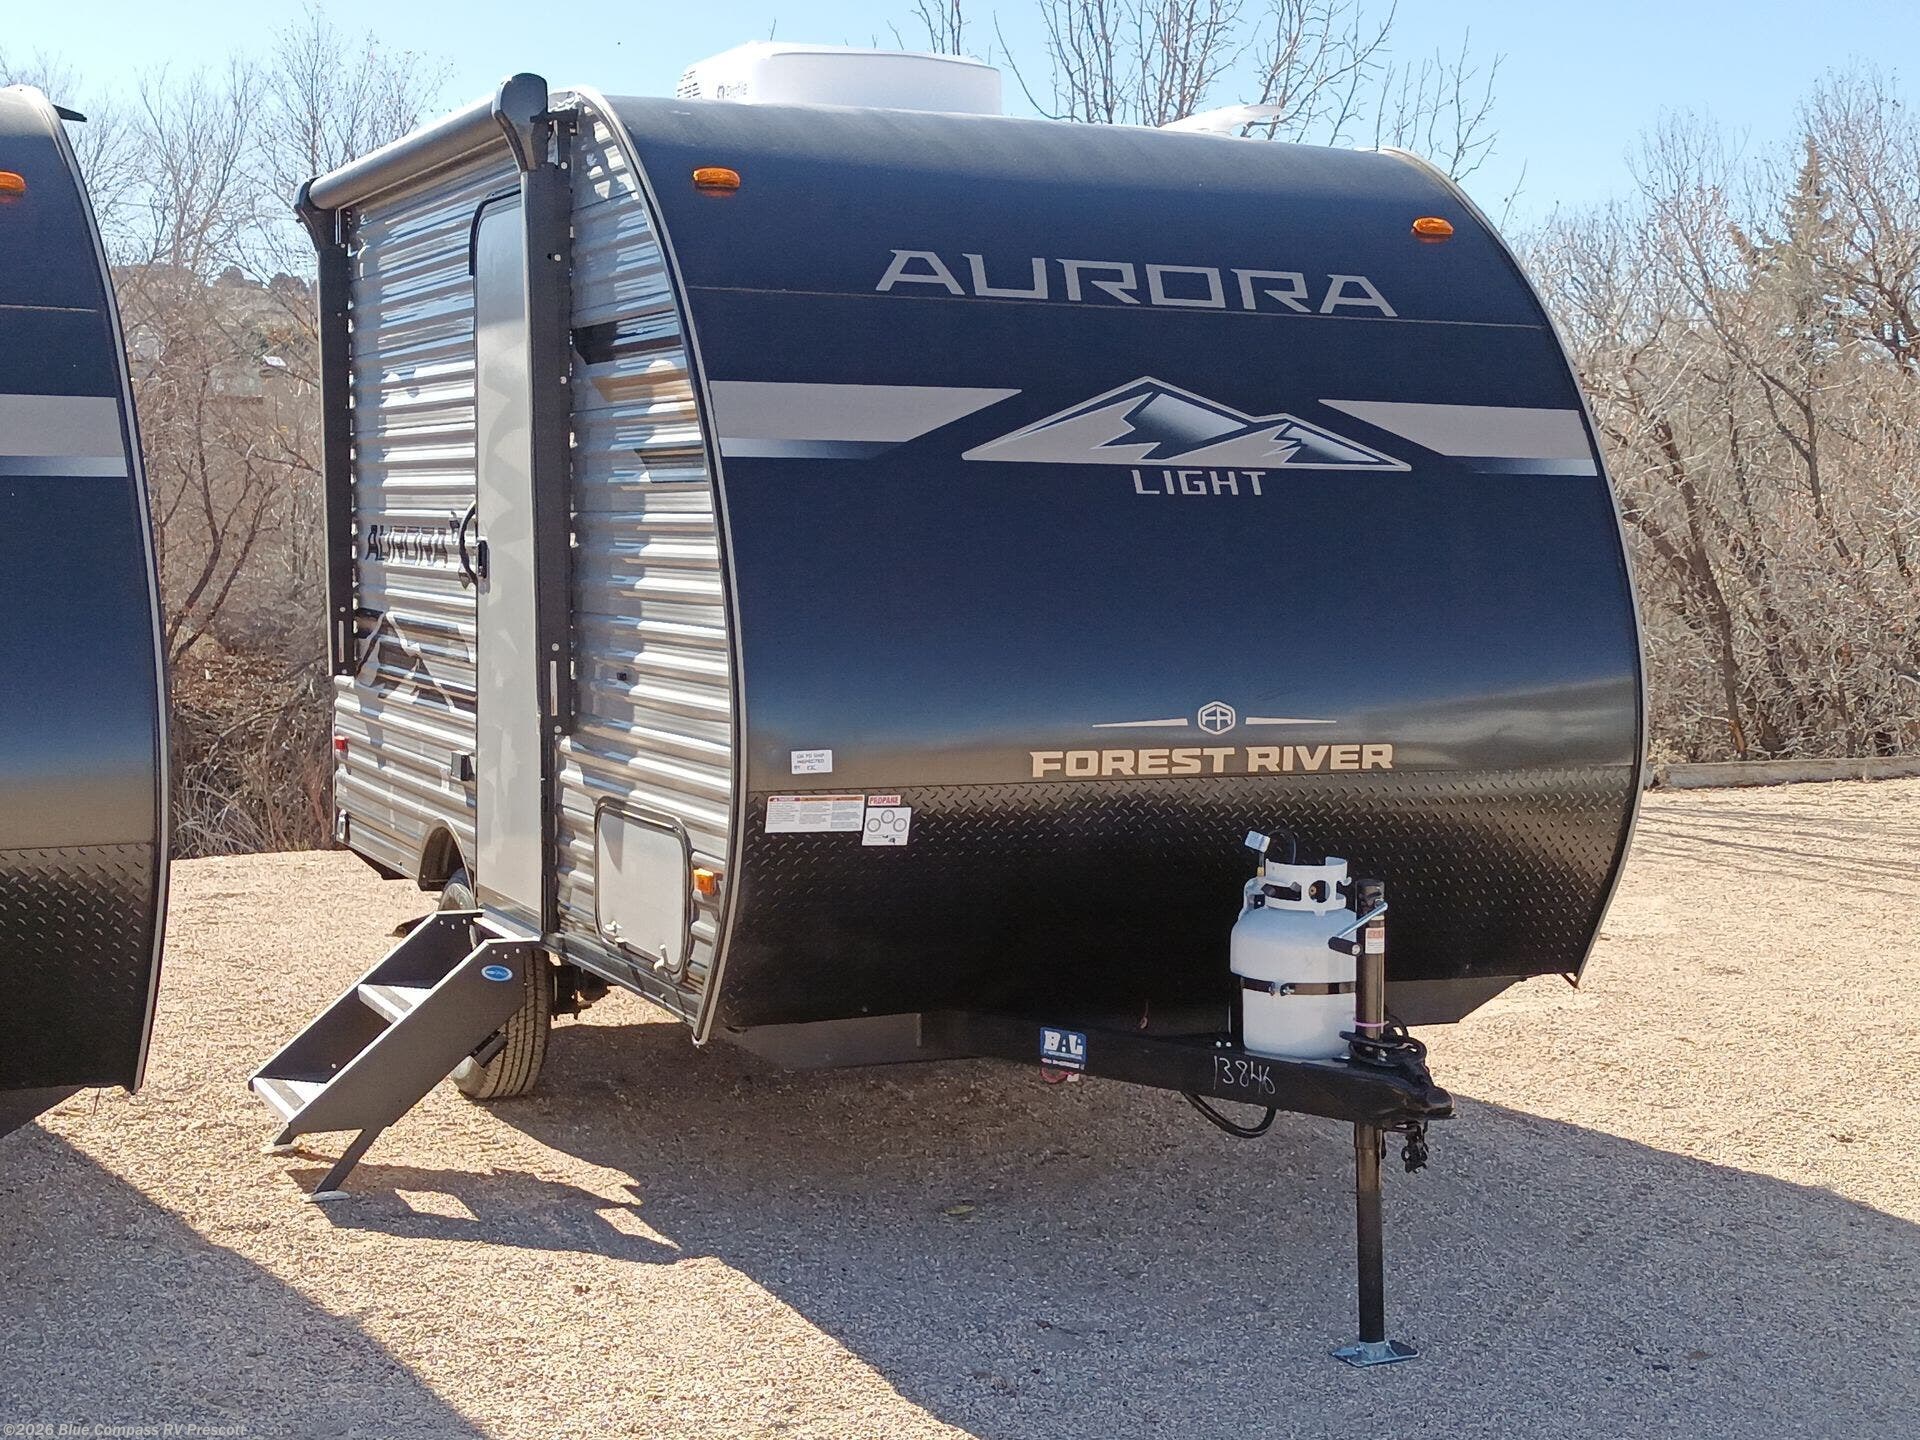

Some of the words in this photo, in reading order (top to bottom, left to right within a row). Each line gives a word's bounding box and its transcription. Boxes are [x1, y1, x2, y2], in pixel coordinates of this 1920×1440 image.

[875, 248, 1398, 317] AURORA
[1131, 469, 1267, 496] LIGHT
[1029, 747, 1236, 778] FOREST
[1245, 743, 1394, 773] RIVER
[868, 796, 900, 805] PROPANE
[1213, 1055, 1276, 1095] 13846
